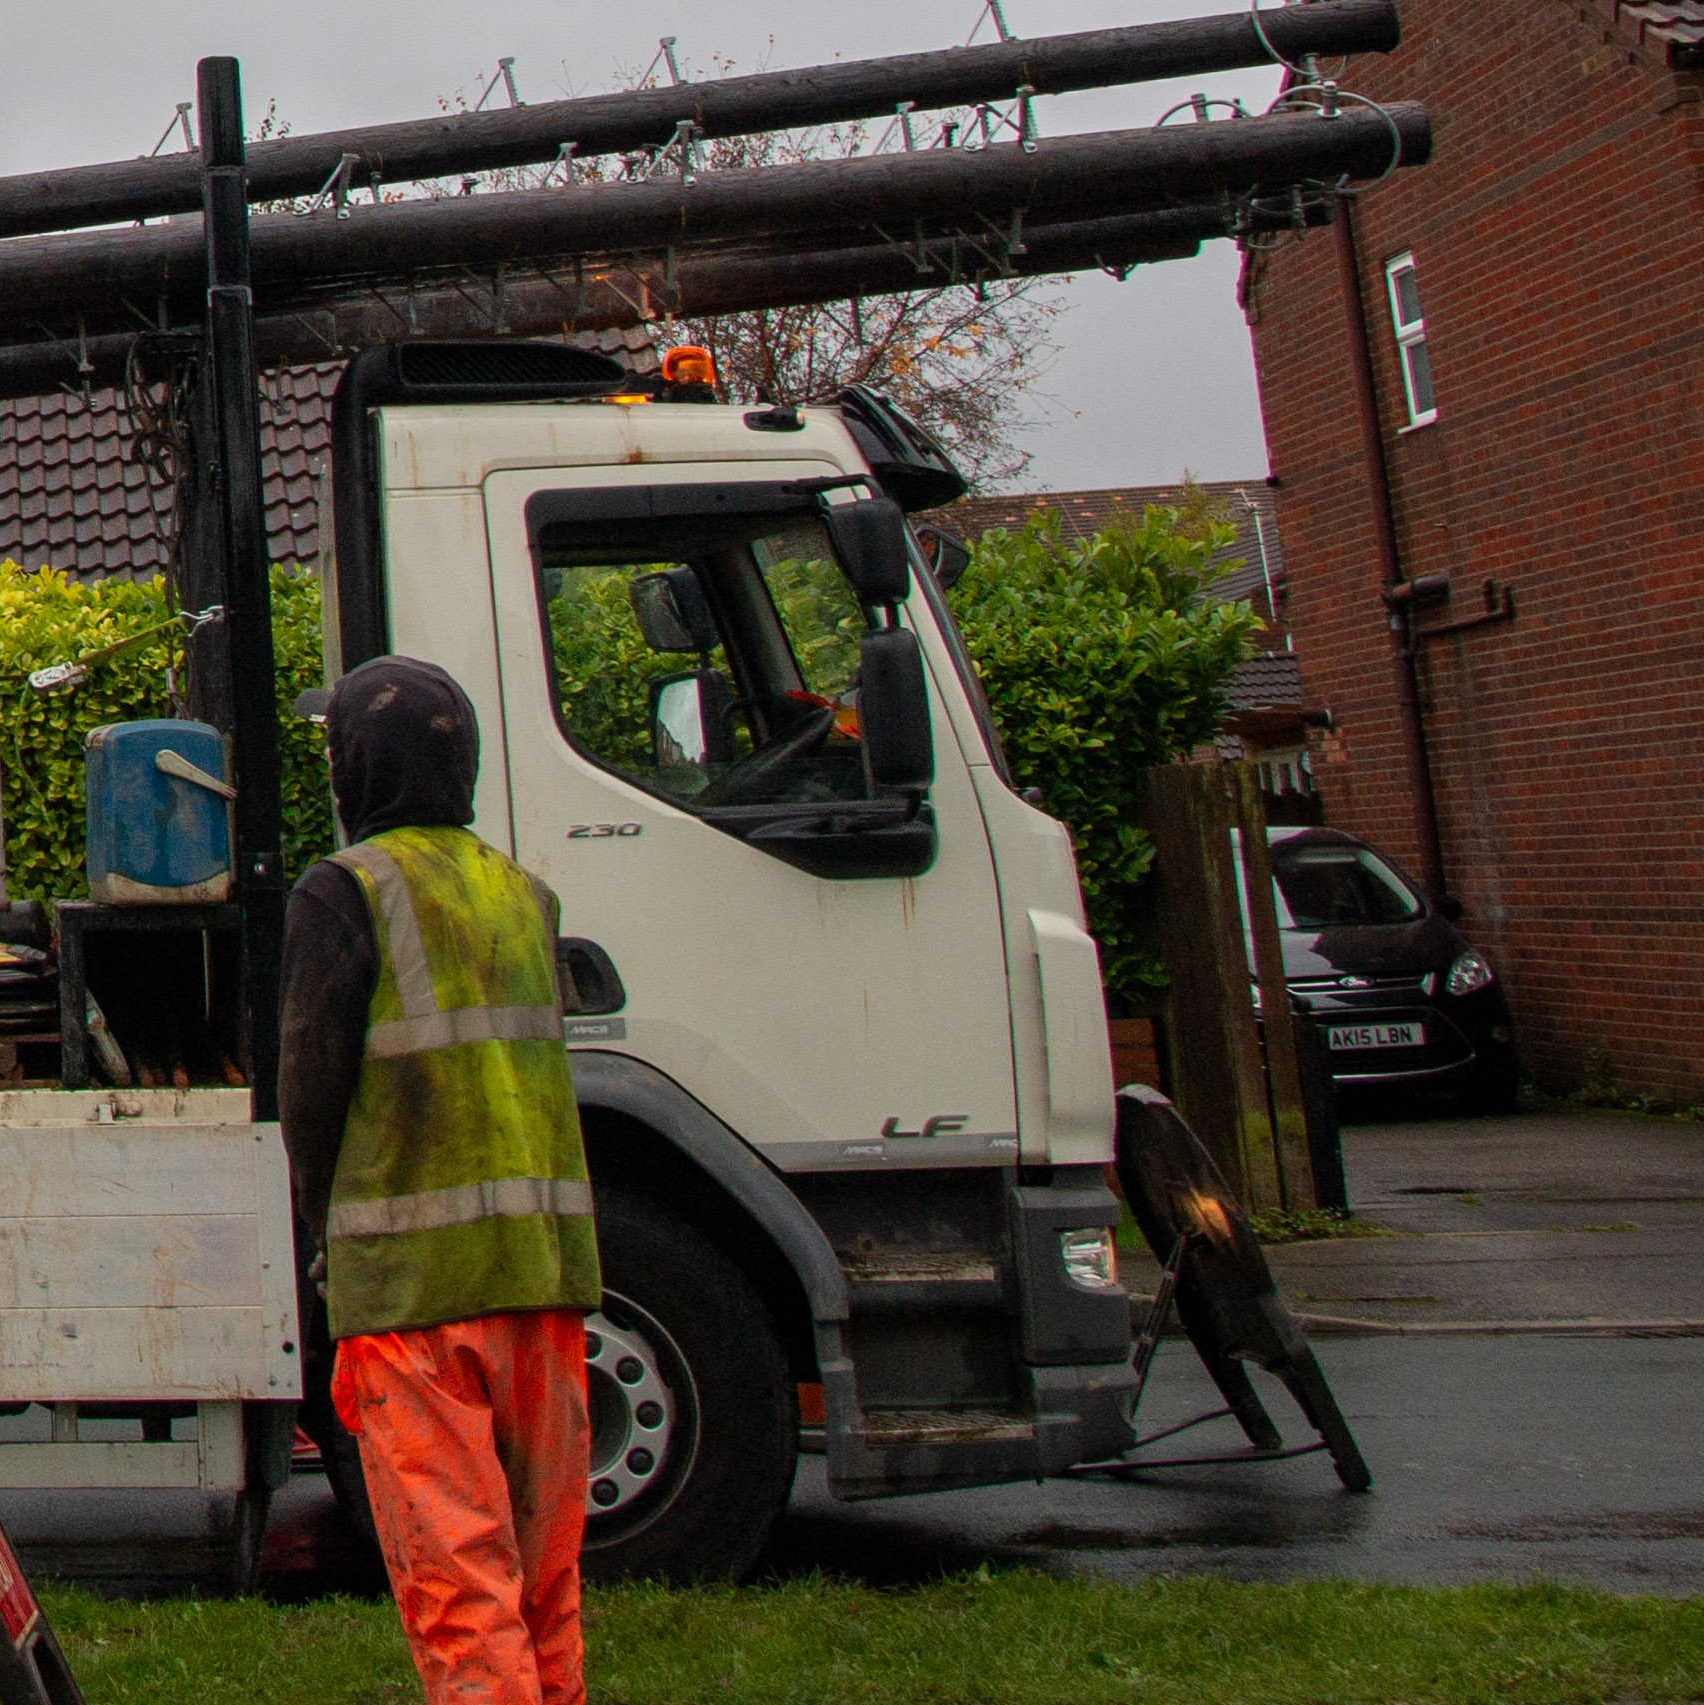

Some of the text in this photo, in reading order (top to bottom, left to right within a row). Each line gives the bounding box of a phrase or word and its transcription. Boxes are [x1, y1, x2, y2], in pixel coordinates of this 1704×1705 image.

[567, 822, 643, 838] 230
[1332, 1026, 1412, 1048] AK15 LBN
[880, 1114, 970, 1138] LF
